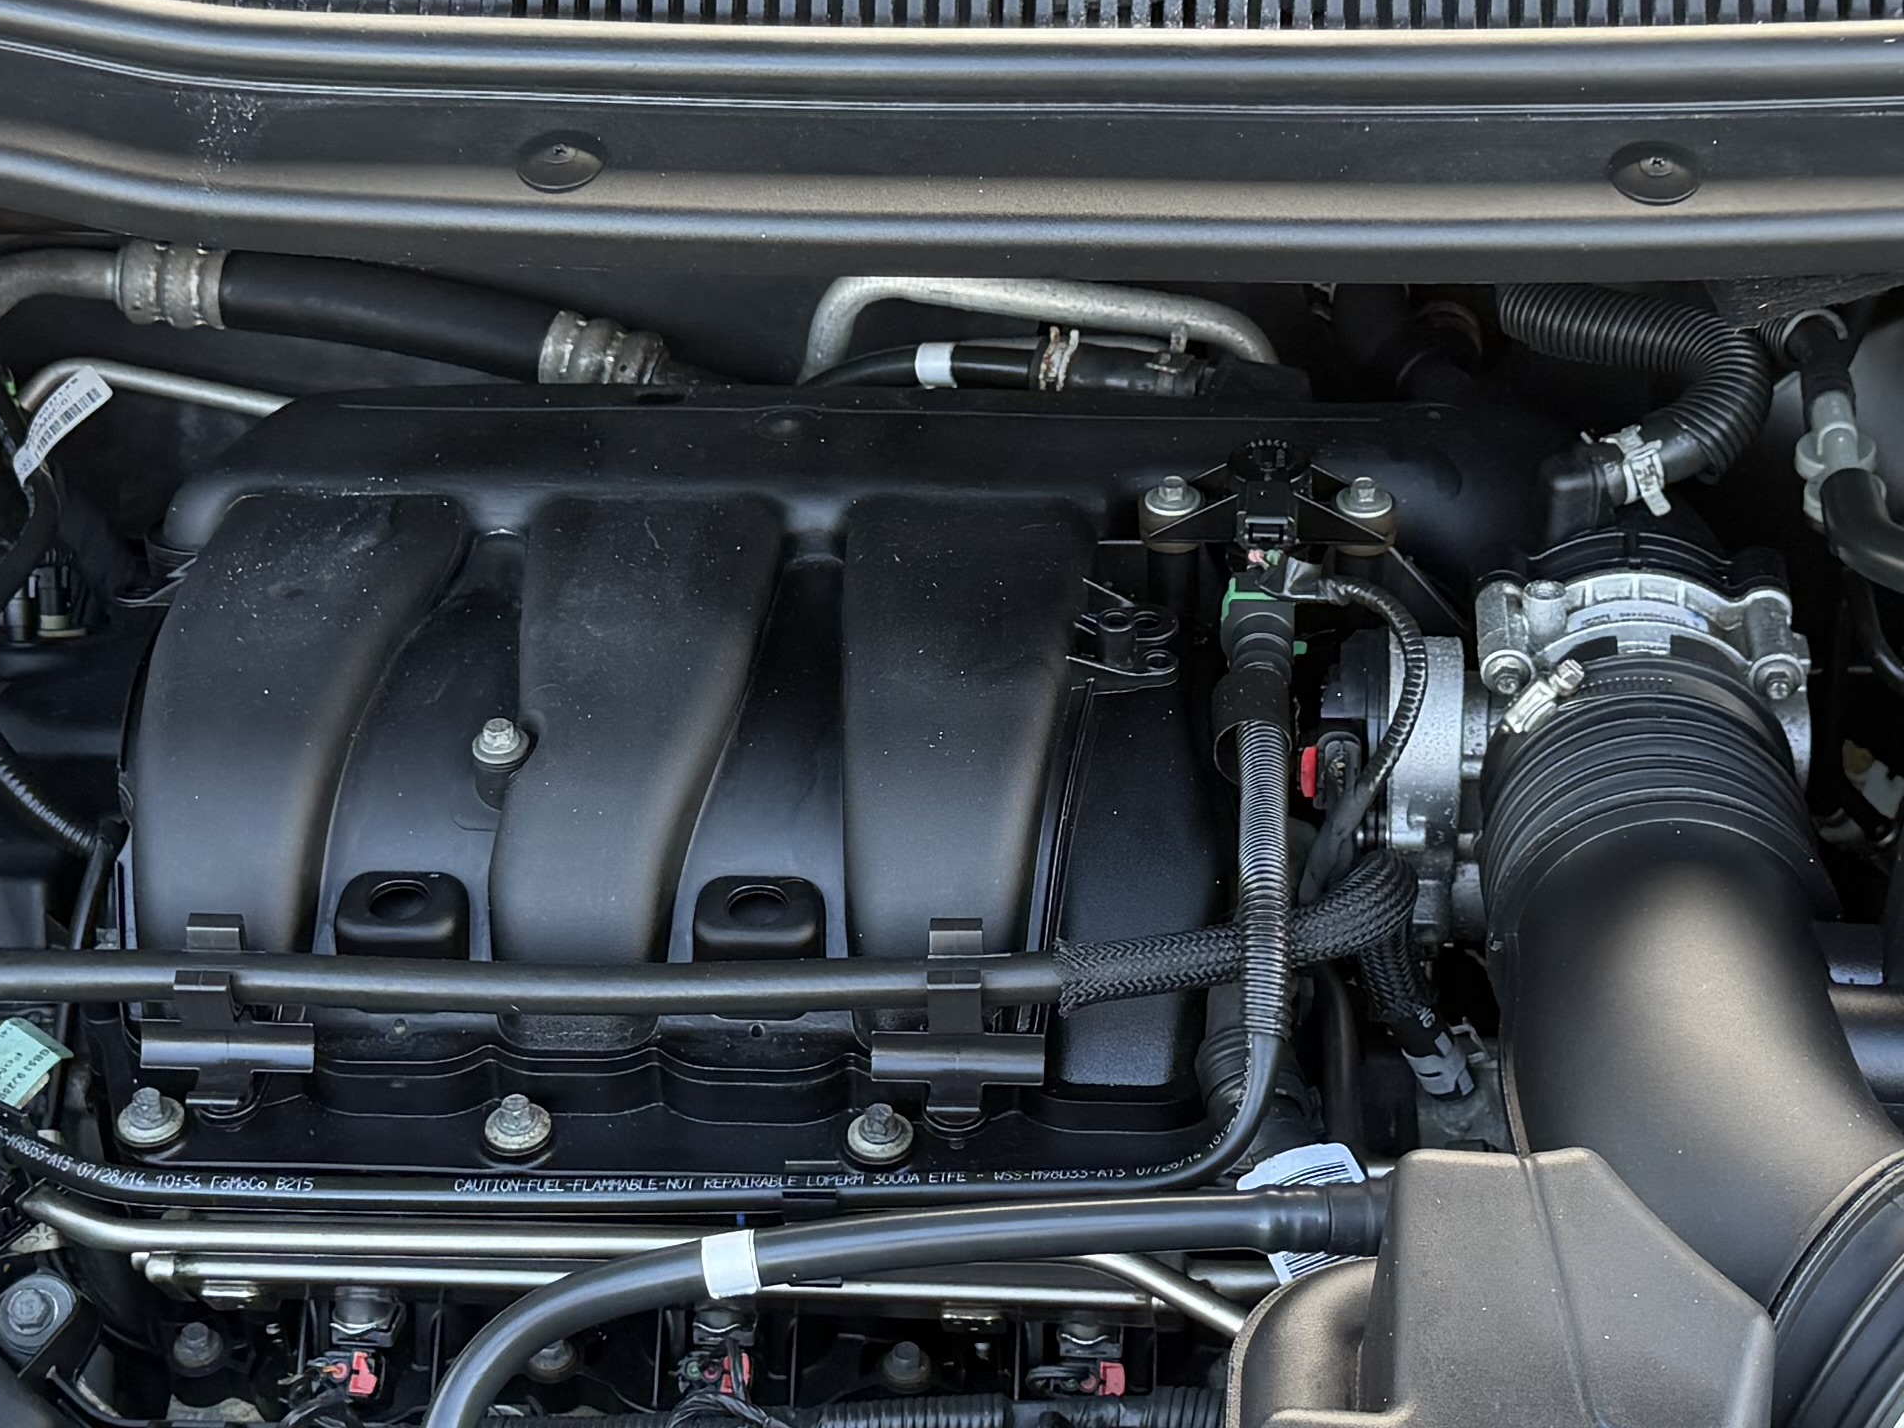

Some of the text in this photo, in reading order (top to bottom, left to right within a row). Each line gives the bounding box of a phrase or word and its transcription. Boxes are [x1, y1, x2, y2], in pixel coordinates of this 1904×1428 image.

[77, 1162, 146, 1187] 07/28/14
[209, 1176, 268, 1192] FoMoCo
[275, 1176, 315, 1191] B215
[702, 1174, 797, 1190] REPAIRABLE
[872, 1172, 920, 1186] 3000A
[928, 1170, 967, 1184] ETFE
